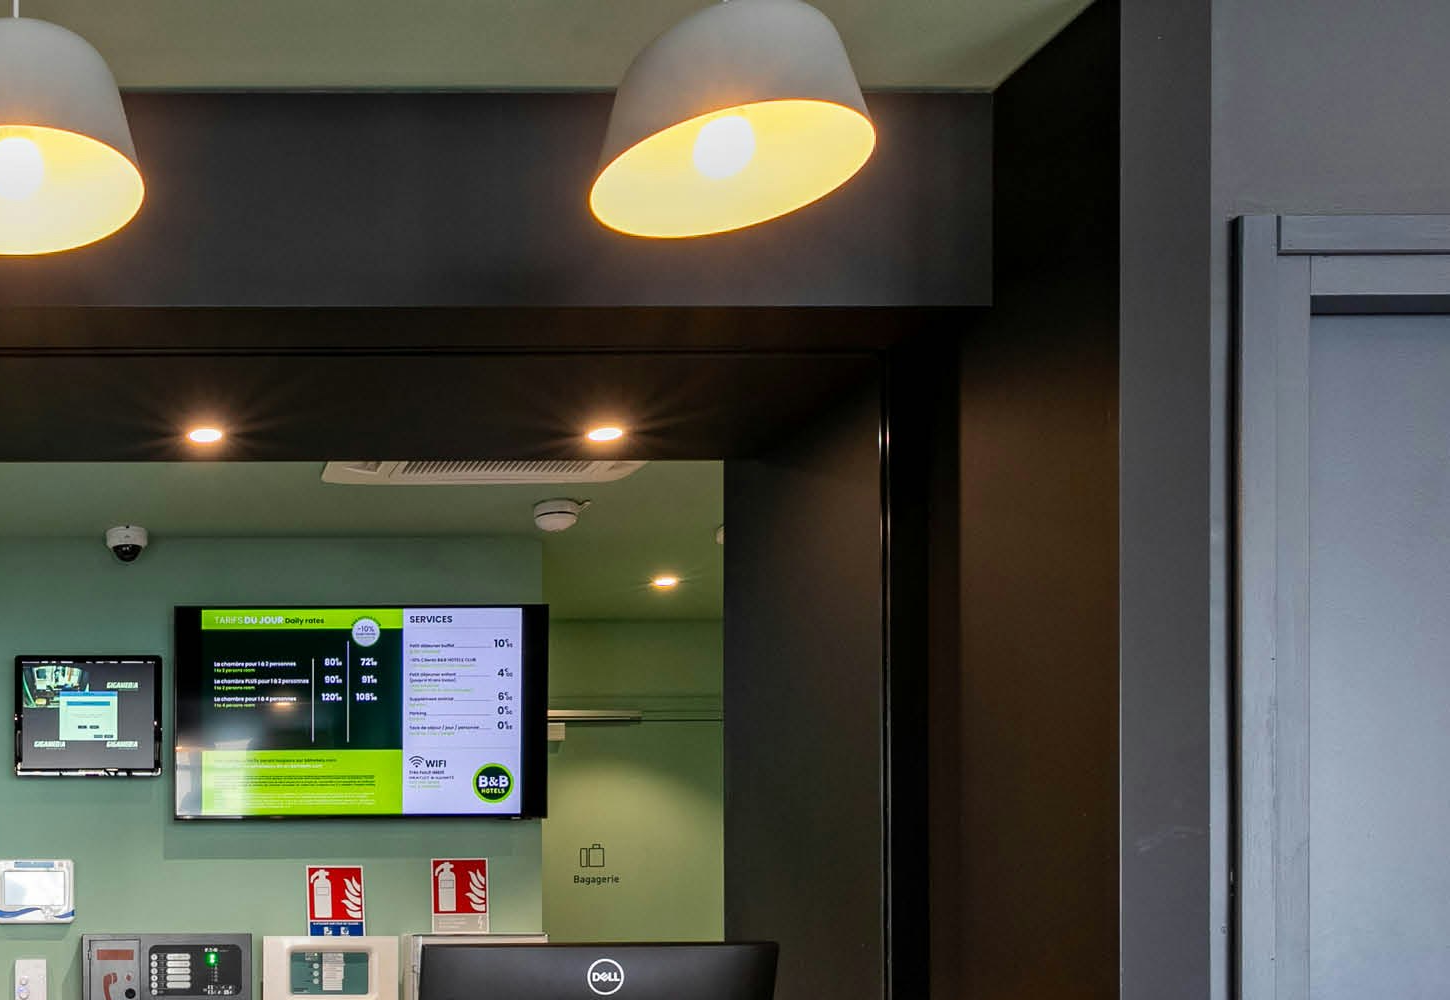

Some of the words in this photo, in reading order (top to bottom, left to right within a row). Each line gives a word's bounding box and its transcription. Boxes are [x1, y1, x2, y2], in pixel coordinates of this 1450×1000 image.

[214, 616, 243, 624] TARIFS
[244, 616, 258, 624] DU
[259, 616, 284, 624] JOUR
[285, 617, 303, 625] Daily
[409, 615, 453, 624] SERVICES
[425, 760, 447, 768] WIFI
[478, 775, 509, 788] B&B
[573, 875, 620, 885] Bagagerie
[592, 972, 620, 982] DELL
